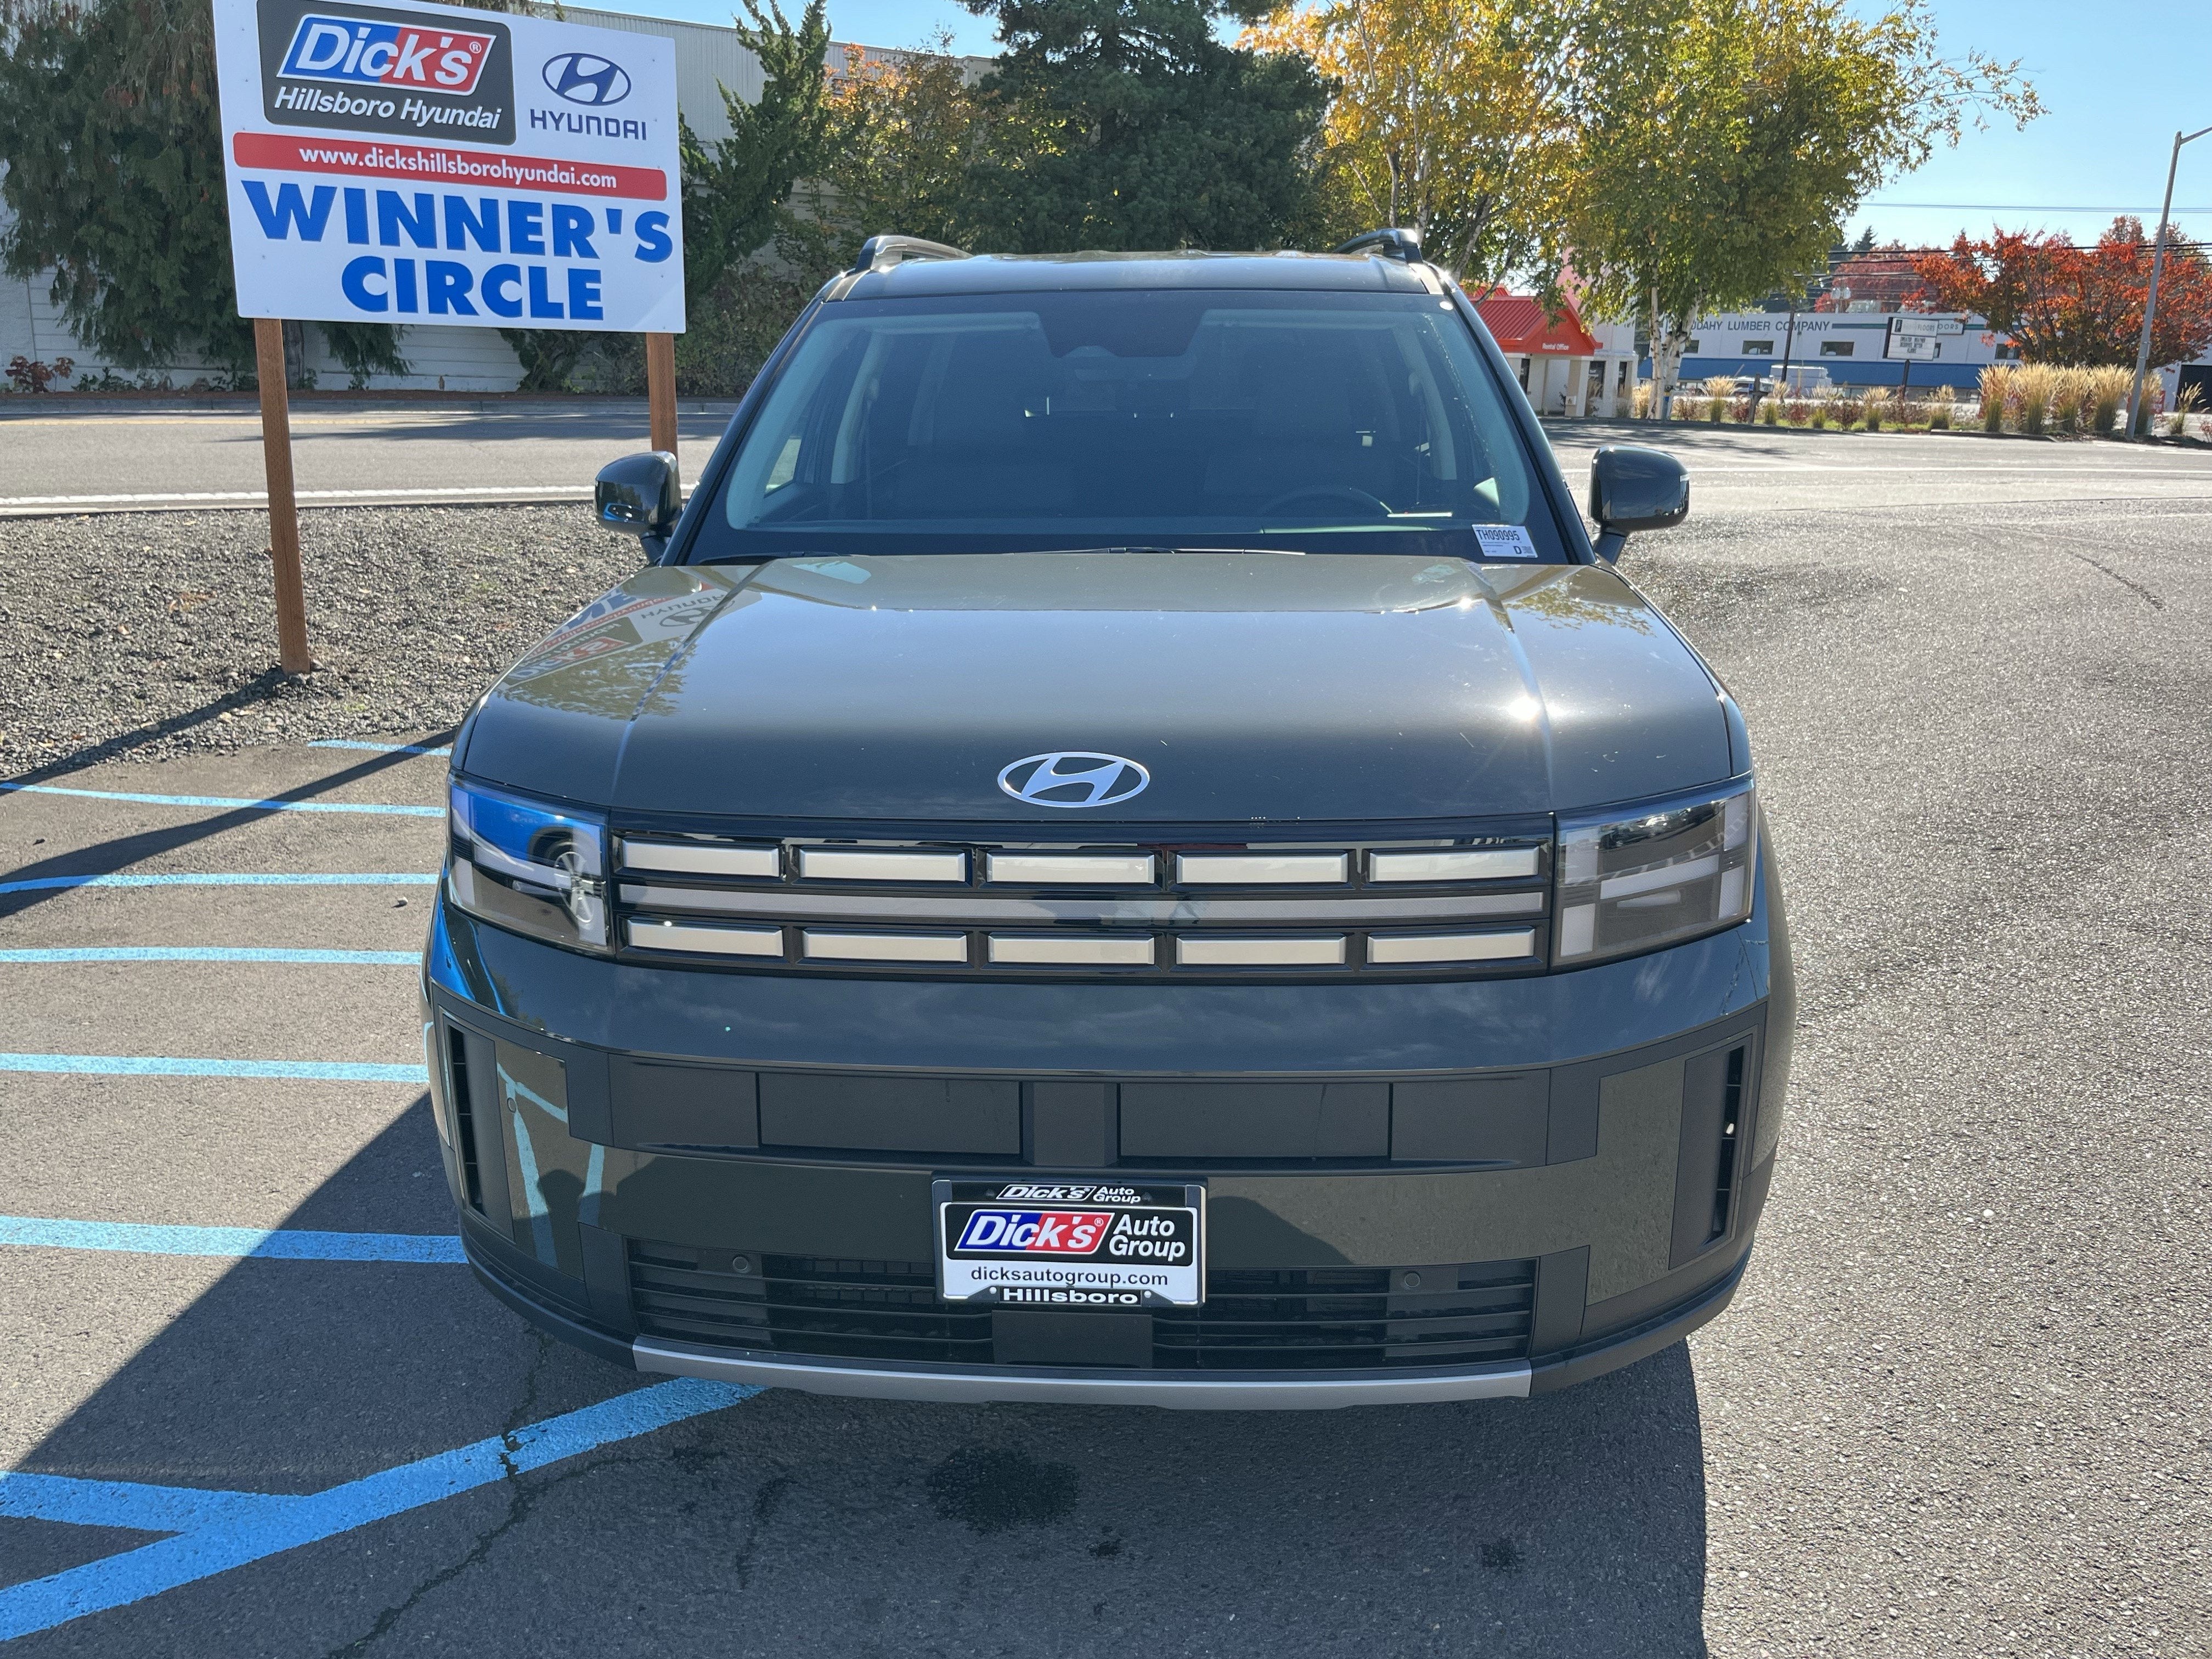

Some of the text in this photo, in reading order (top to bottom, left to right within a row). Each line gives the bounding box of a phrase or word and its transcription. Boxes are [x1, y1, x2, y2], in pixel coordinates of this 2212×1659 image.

[274, 86, 502, 129] Hillsboro Hyundai
[531, 109, 646, 140] HYUNDAI
[299, 146, 617, 189] www.dickshillsborohyundai.com
[241, 180, 673, 263] WINNER'S
[341, 256, 603, 320] CIRCLE
[1728, 321, 1771, 331] LUMBER
[1775, 321, 1831, 331] COMPANY
[1476, 529, 1520, 540] TH090995
[1093, 1194, 1141, 1204] Group
[1096, 1186, 1135, 1195] Auto
[1113, 1214, 1175, 1236] Auto
[1109, 1234, 1186, 1261] Group
[971, 1266, 1168, 1288] dicksautogroup.com
[1004, 1288, 1138, 1304] Hillsboro
